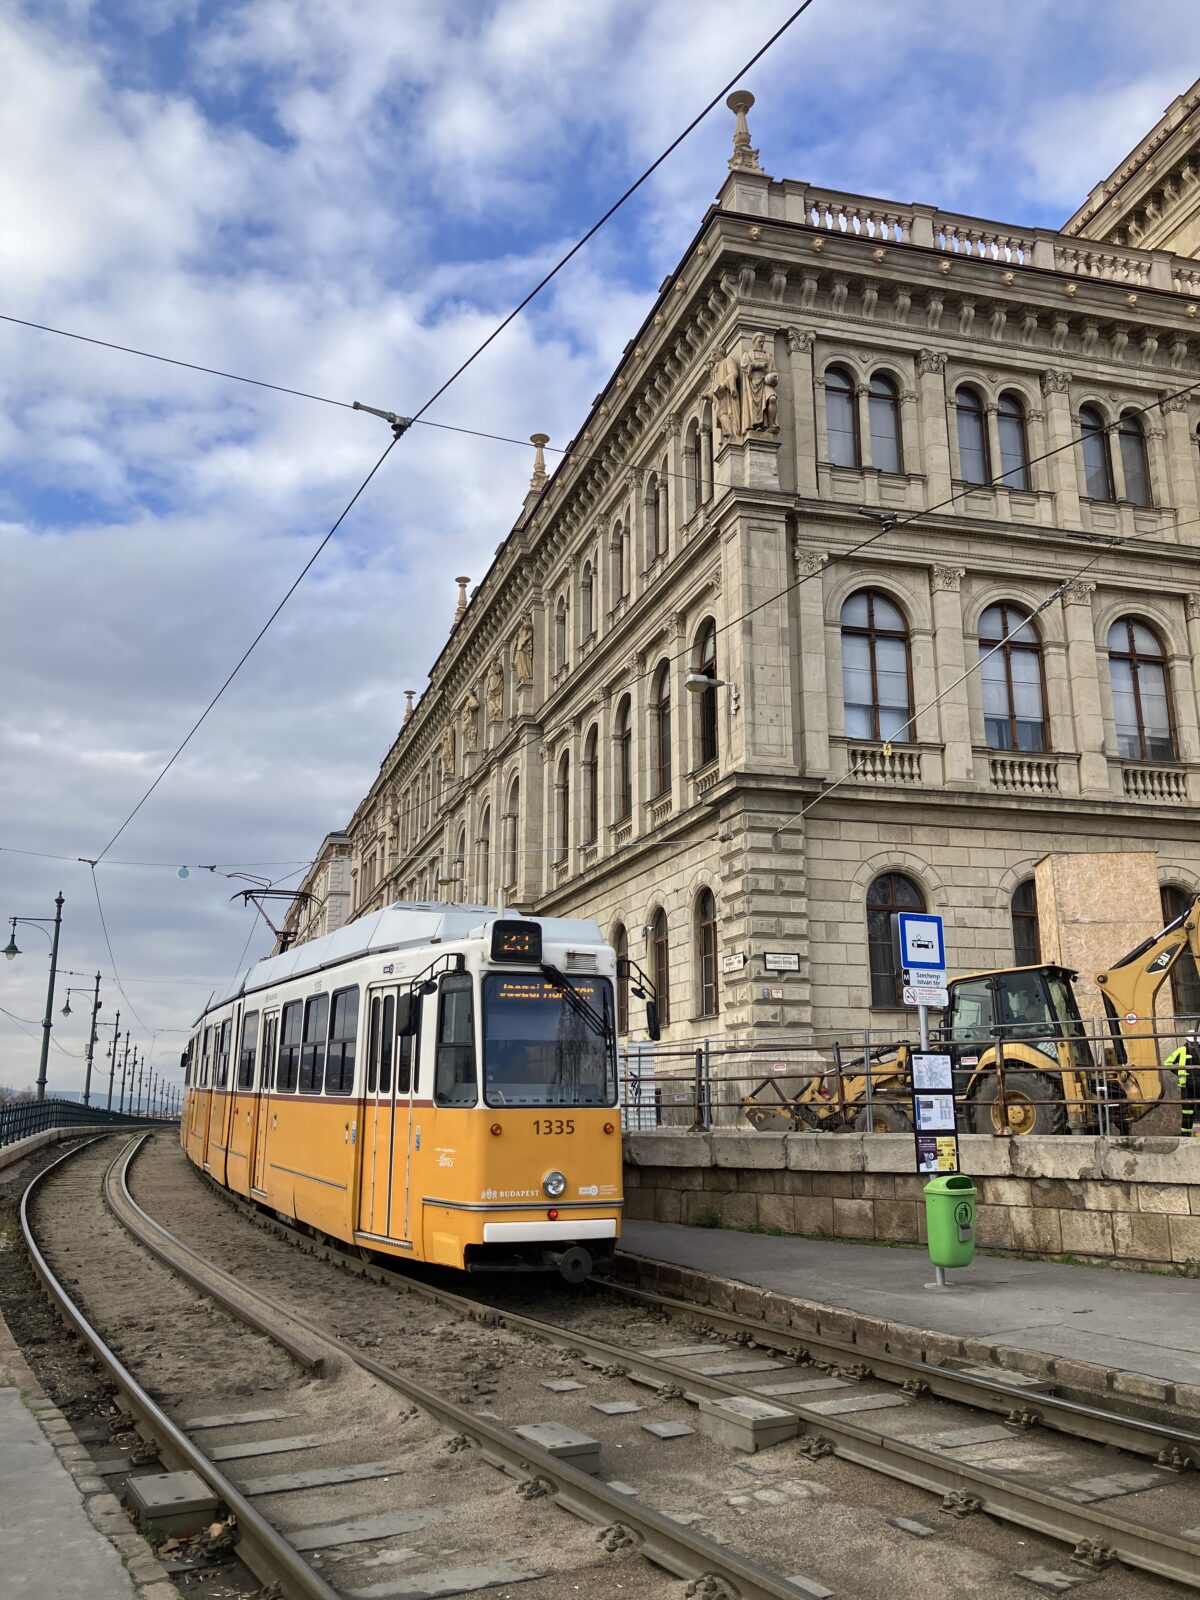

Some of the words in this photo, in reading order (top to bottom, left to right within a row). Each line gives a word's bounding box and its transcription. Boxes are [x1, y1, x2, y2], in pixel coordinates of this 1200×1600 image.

[1157, 952, 1171, 966] CAT
[533, 1120, 575, 1135] 1335
[499, 1189, 540, 1198] BUDAPEST
